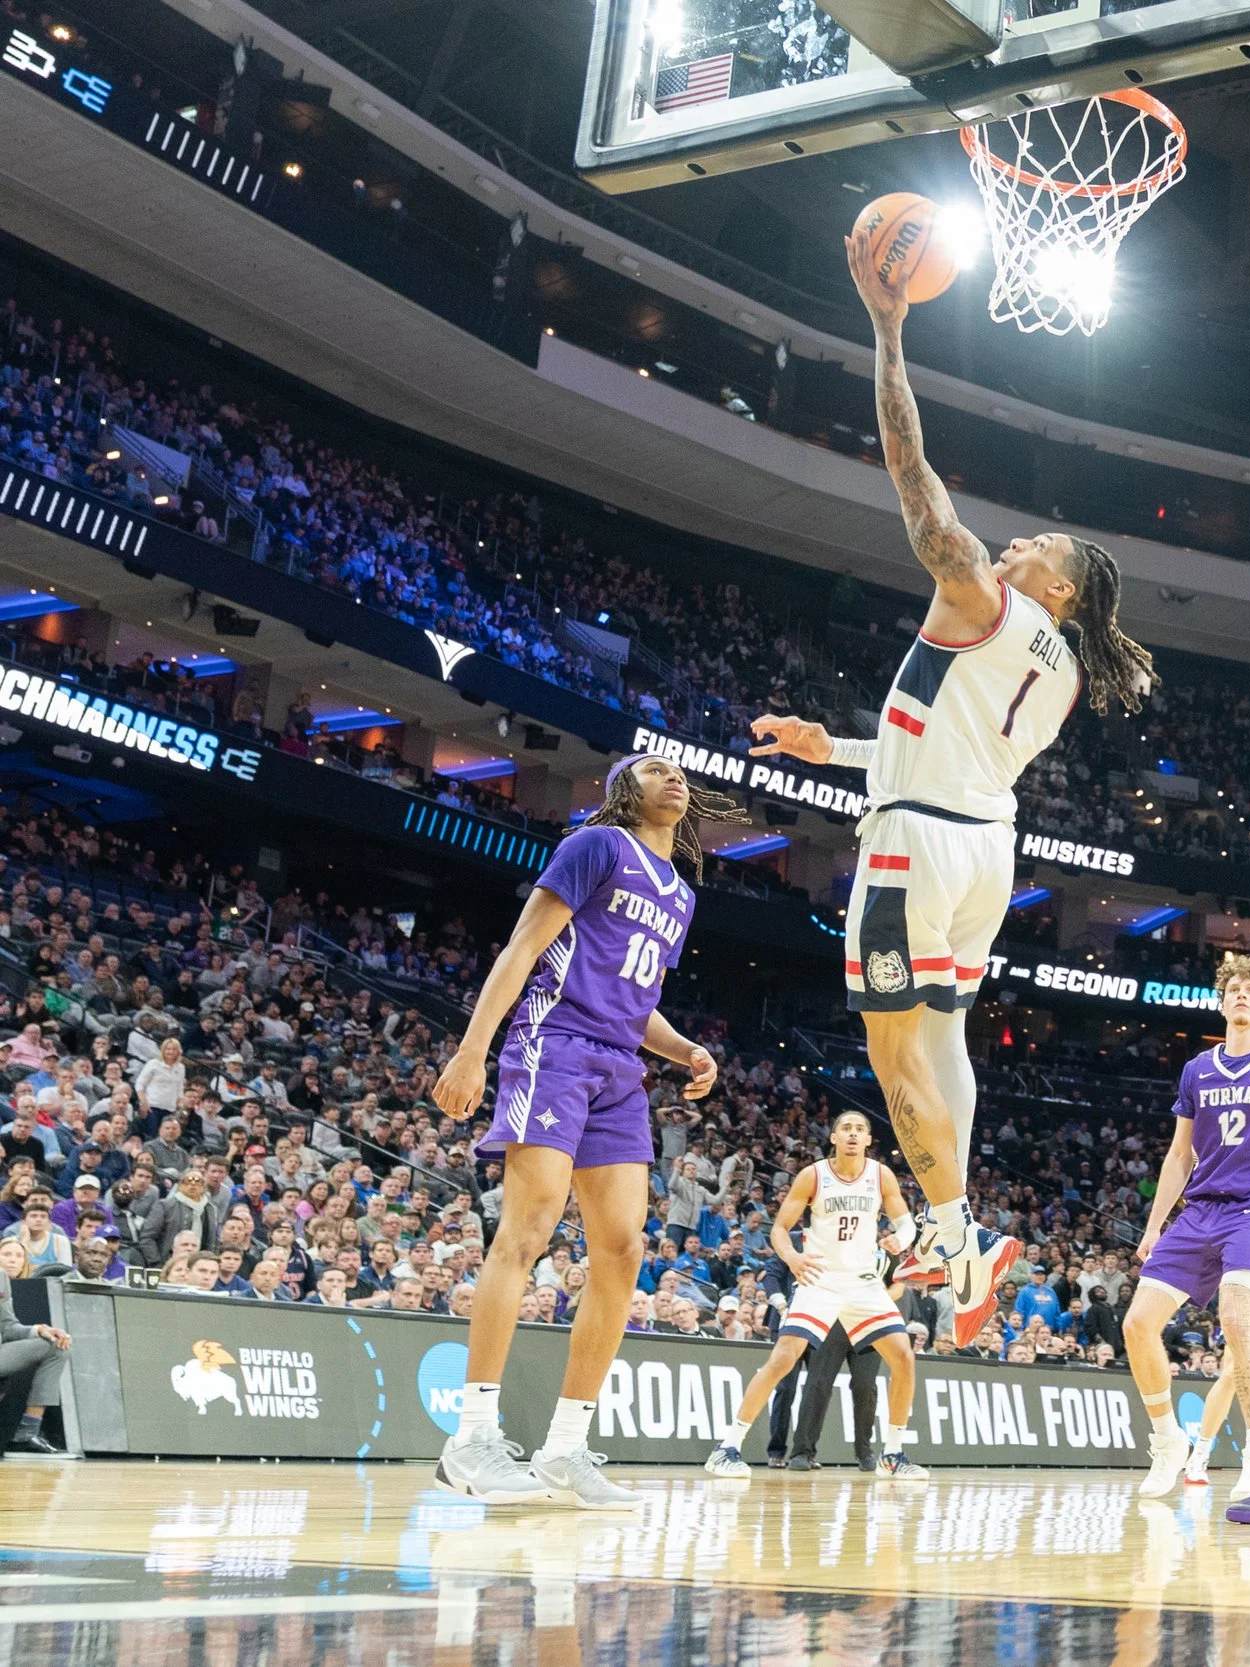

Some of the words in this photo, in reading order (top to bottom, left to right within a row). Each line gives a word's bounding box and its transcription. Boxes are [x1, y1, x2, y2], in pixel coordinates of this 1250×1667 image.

[1028, 628, 1064, 671] BALL
[1000, 668, 1041, 739] 1
[633, 727, 745, 783] FURMAN
[1021, 833, 1135, 876] HUSKIES
[619, 932, 660, 989] 10
[1034, 963, 1138, 1001] SECOND
[1218, 1109, 1246, 1146] 12
[824, 1195, 874, 1214] CONNECTICUT
[239, 1348, 313, 1368] BUFFALO
[241, 1365, 317, 1396] WILD
[245, 1394, 320, 1419] WINGS
[598, 1358, 744, 1441] ROAD
[926, 1379, 1037, 1446] FINAL
[1040, 1386, 1136, 1449] FOUR
